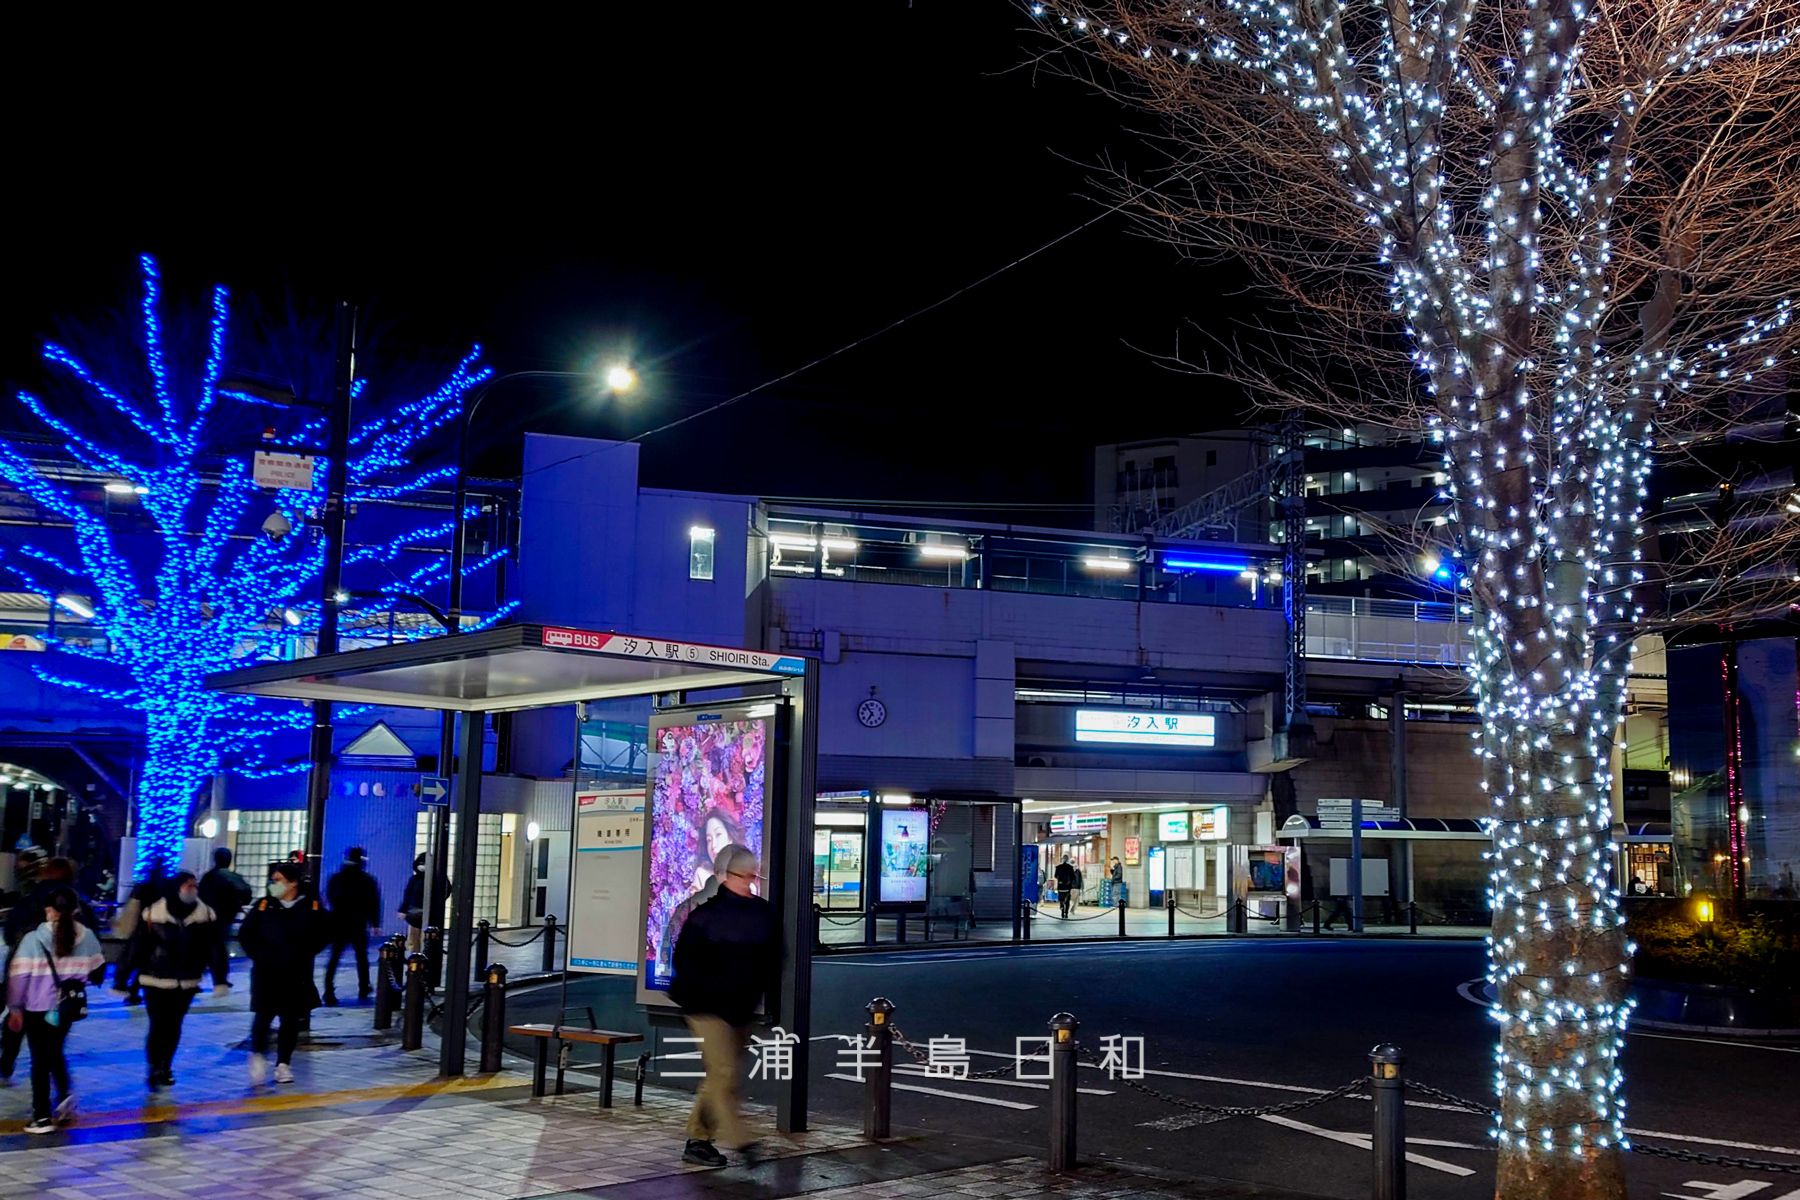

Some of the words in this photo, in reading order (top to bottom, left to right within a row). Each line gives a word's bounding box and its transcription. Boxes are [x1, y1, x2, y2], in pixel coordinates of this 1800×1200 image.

[270, 470, 296, 478] POLICE
[574, 633, 599, 647] BUS
[623, 638, 679, 659] 汐入駅
[709, 650, 749, 664] SHIOIRI
[751, 655, 770, 667] Sta.
[1127, 715, 1178, 730] 汐入駅
